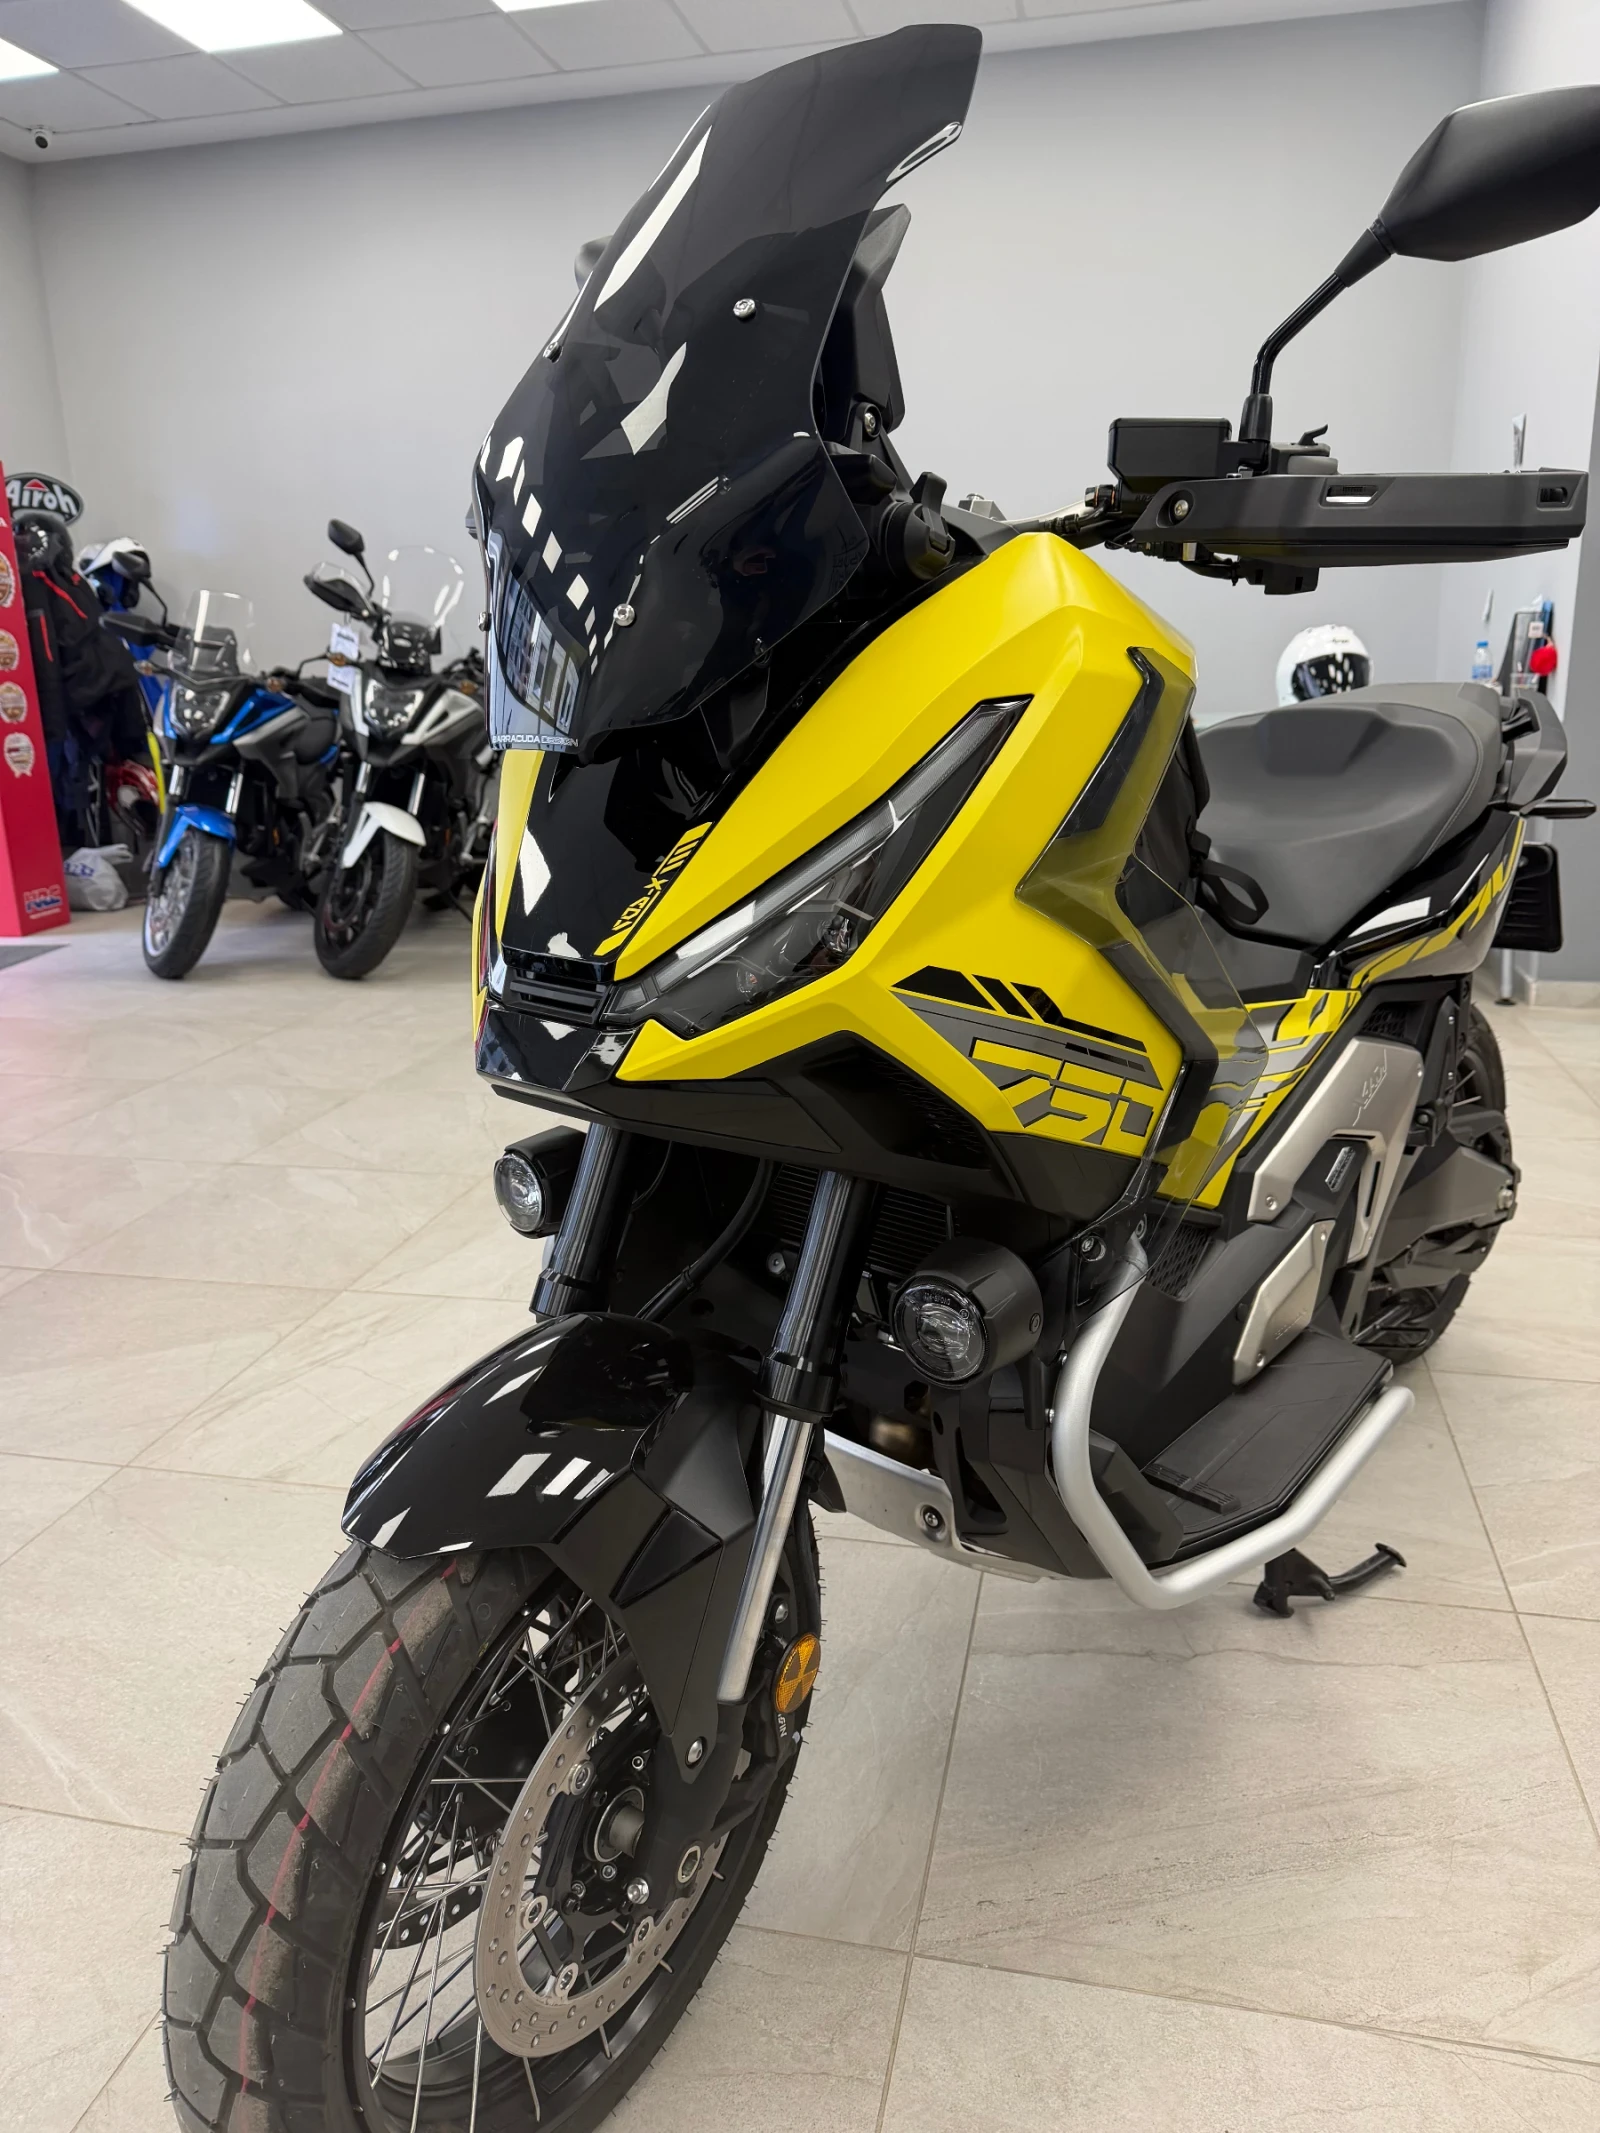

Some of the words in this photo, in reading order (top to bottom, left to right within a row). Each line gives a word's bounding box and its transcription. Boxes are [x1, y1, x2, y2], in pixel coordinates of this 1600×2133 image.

[6, 480, 78, 516] Airoh
[492, 734, 541, 744] BARRACUDA
[612, 877, 669, 931] X-ADV
[968, 1036, 1154, 1157] 750
